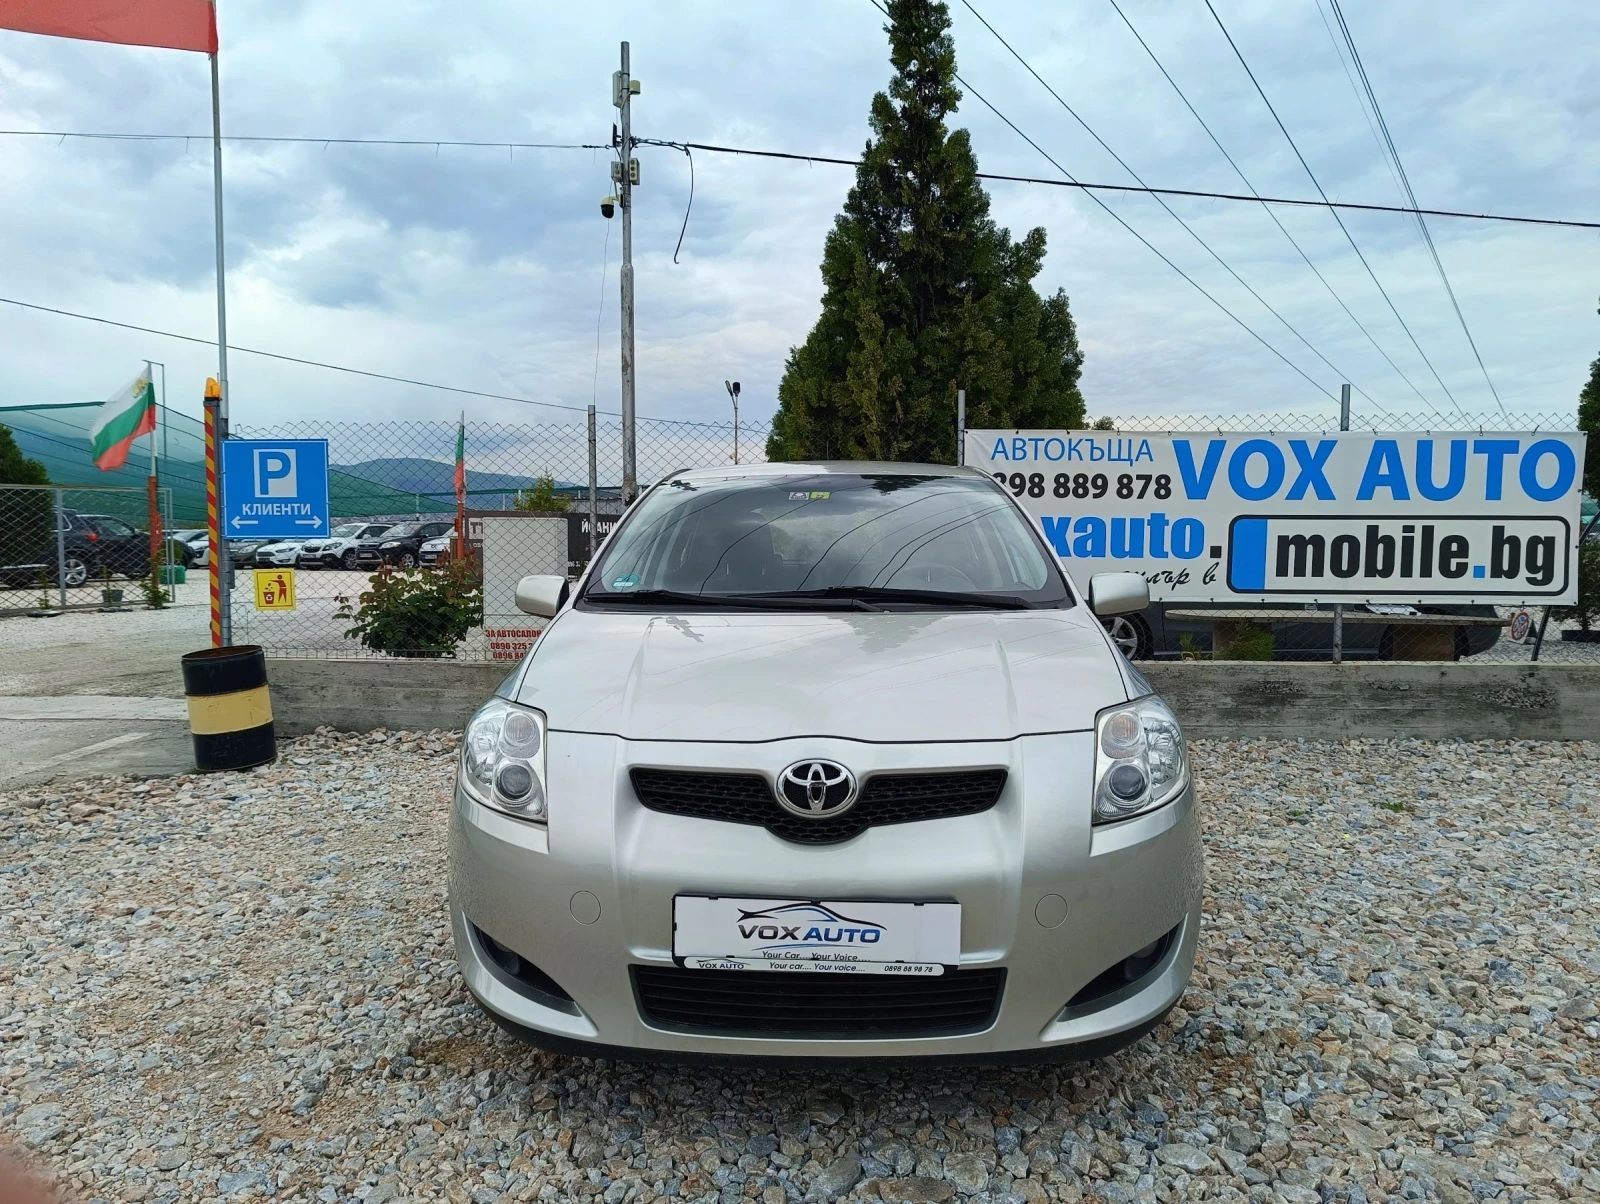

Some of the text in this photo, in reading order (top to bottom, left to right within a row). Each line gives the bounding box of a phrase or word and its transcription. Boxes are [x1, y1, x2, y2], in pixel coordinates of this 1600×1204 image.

[990, 437, 1154, 467] АВТОКЪЩА
[259, 451, 291, 495] P
[1172, 439, 1576, 502] VOX AUTO
[1053, 472, 1109, 499] 889
[1116, 473, 1172, 500] 878
[242, 503, 311, 516] КЛИЕНТИ
[1275, 524, 1556, 587] mobile.bg
[738, 924, 881, 943] VOX AUTO
[762, 951, 782, 959] Your
[769, 962, 787, 970] Your
[814, 963, 833, 971] Your
